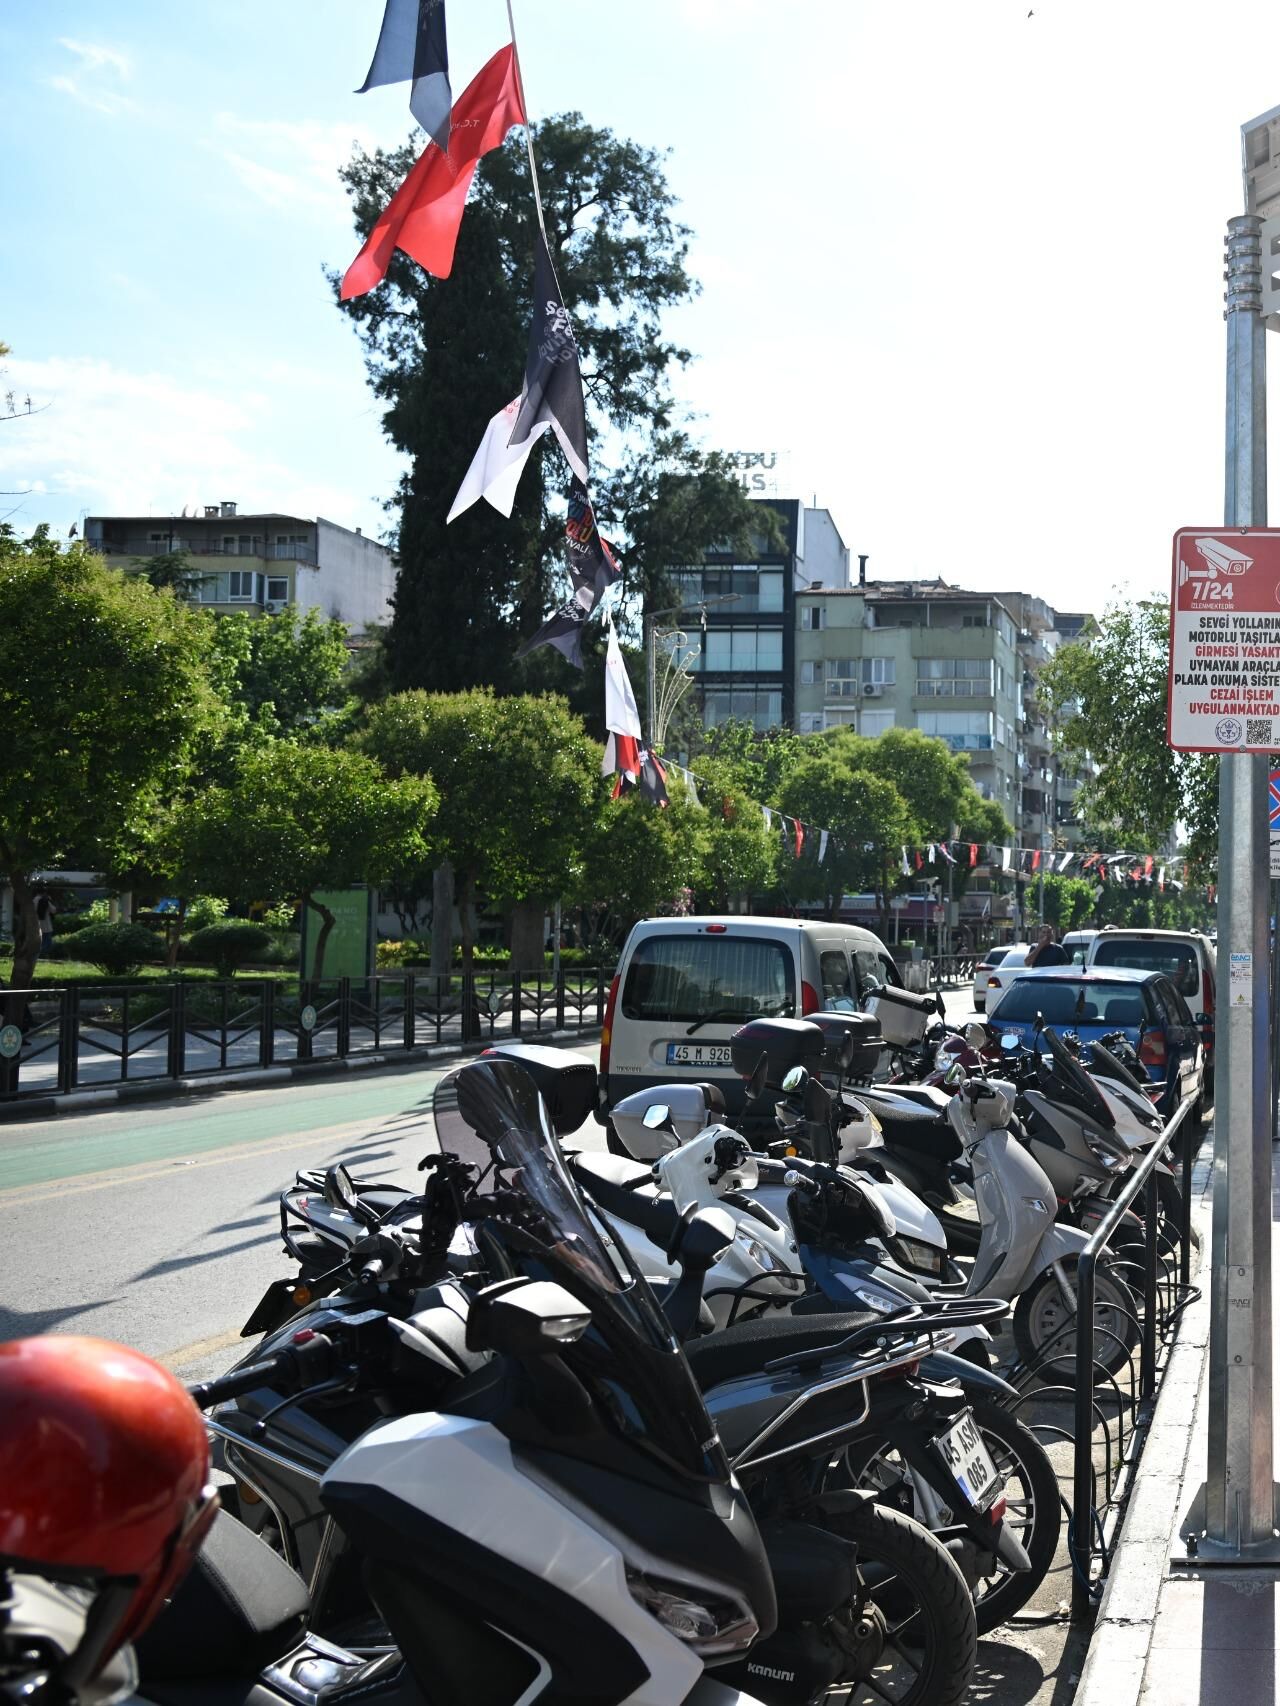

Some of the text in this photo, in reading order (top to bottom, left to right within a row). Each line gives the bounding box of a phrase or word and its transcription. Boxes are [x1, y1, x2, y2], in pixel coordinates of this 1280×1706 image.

[1192, 582, 1234, 600] 7/24
[1199, 614, 1230, 629] SEVGİ
[1189, 631, 1237, 644] MOTORLU
[1195, 643, 1239, 658] GİRMESİ
[1189, 660, 1239, 672] UYMAYAN
[1174, 674, 1208, 686] PLAKA
[1211, 674, 1248, 686] OKUMA
[1210, 686, 1274, 703] CEZAİ İŞLEM
[675, 1047, 731, 1061] 45 M 926
[942, 1438, 961, 1467] 45
[967, 1456, 988, 1492] 085
